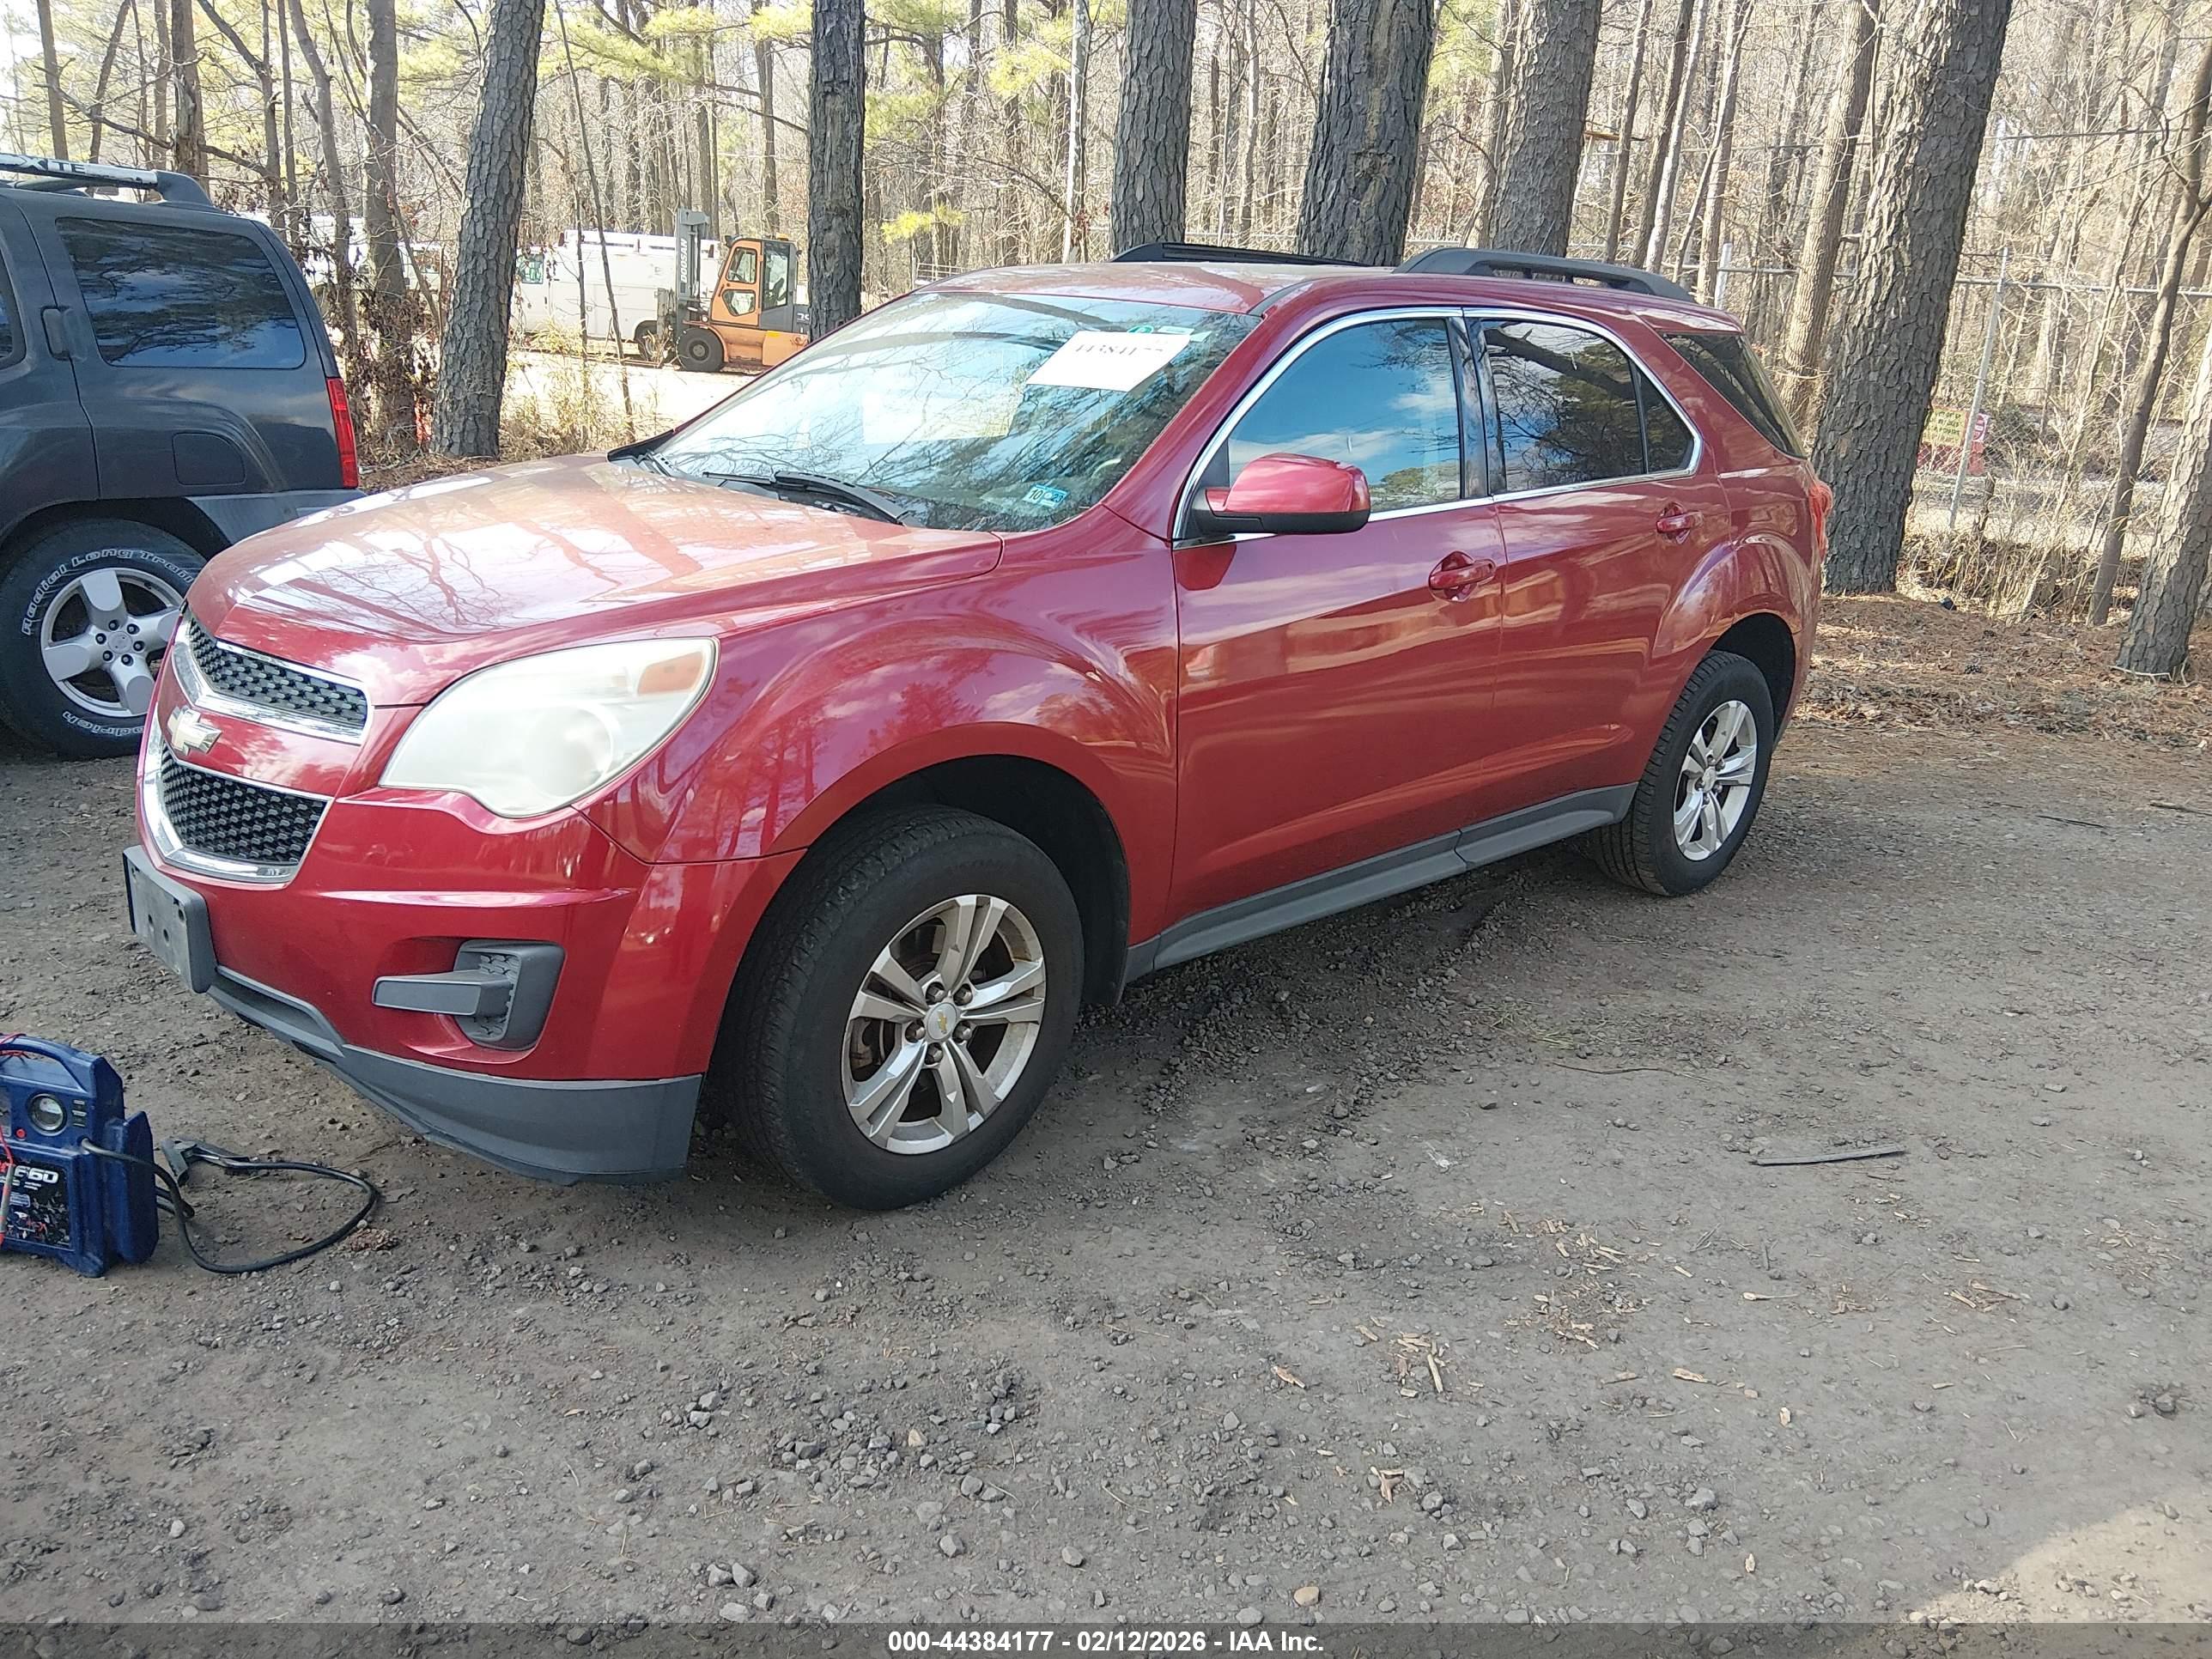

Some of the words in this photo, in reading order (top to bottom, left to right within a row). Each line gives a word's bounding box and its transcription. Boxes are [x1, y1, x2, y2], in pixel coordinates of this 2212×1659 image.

[1029, 489, 1043, 501] 10
[21, 564, 67, 635] Radial
[71, 548, 133, 568] Long
[139, 549, 195, 584] Trail
